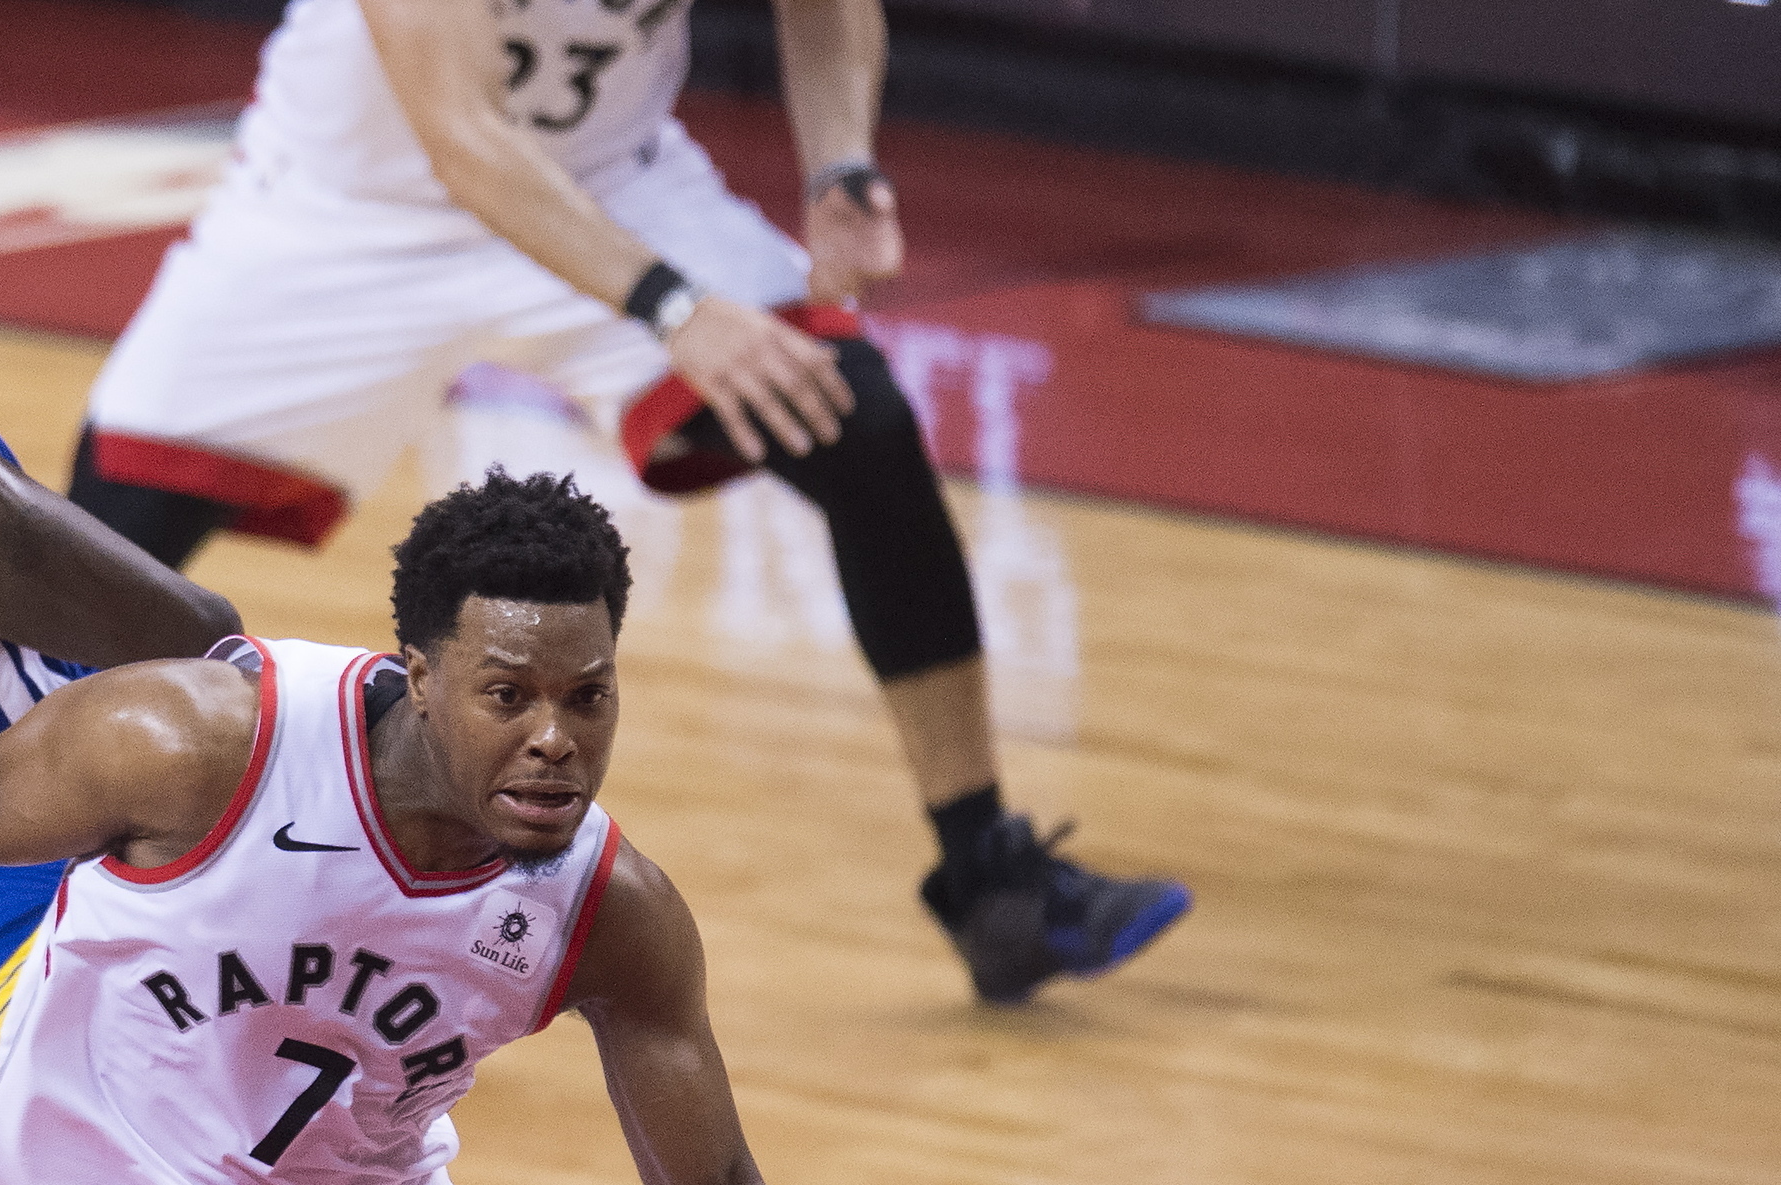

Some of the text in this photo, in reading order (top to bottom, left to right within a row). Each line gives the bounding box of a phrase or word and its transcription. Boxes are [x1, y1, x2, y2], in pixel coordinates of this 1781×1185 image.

[471, 939, 530, 974] Sun Life
[140, 943, 470, 1104] RAPTOR
[248, 1036, 358, 1168] 7
